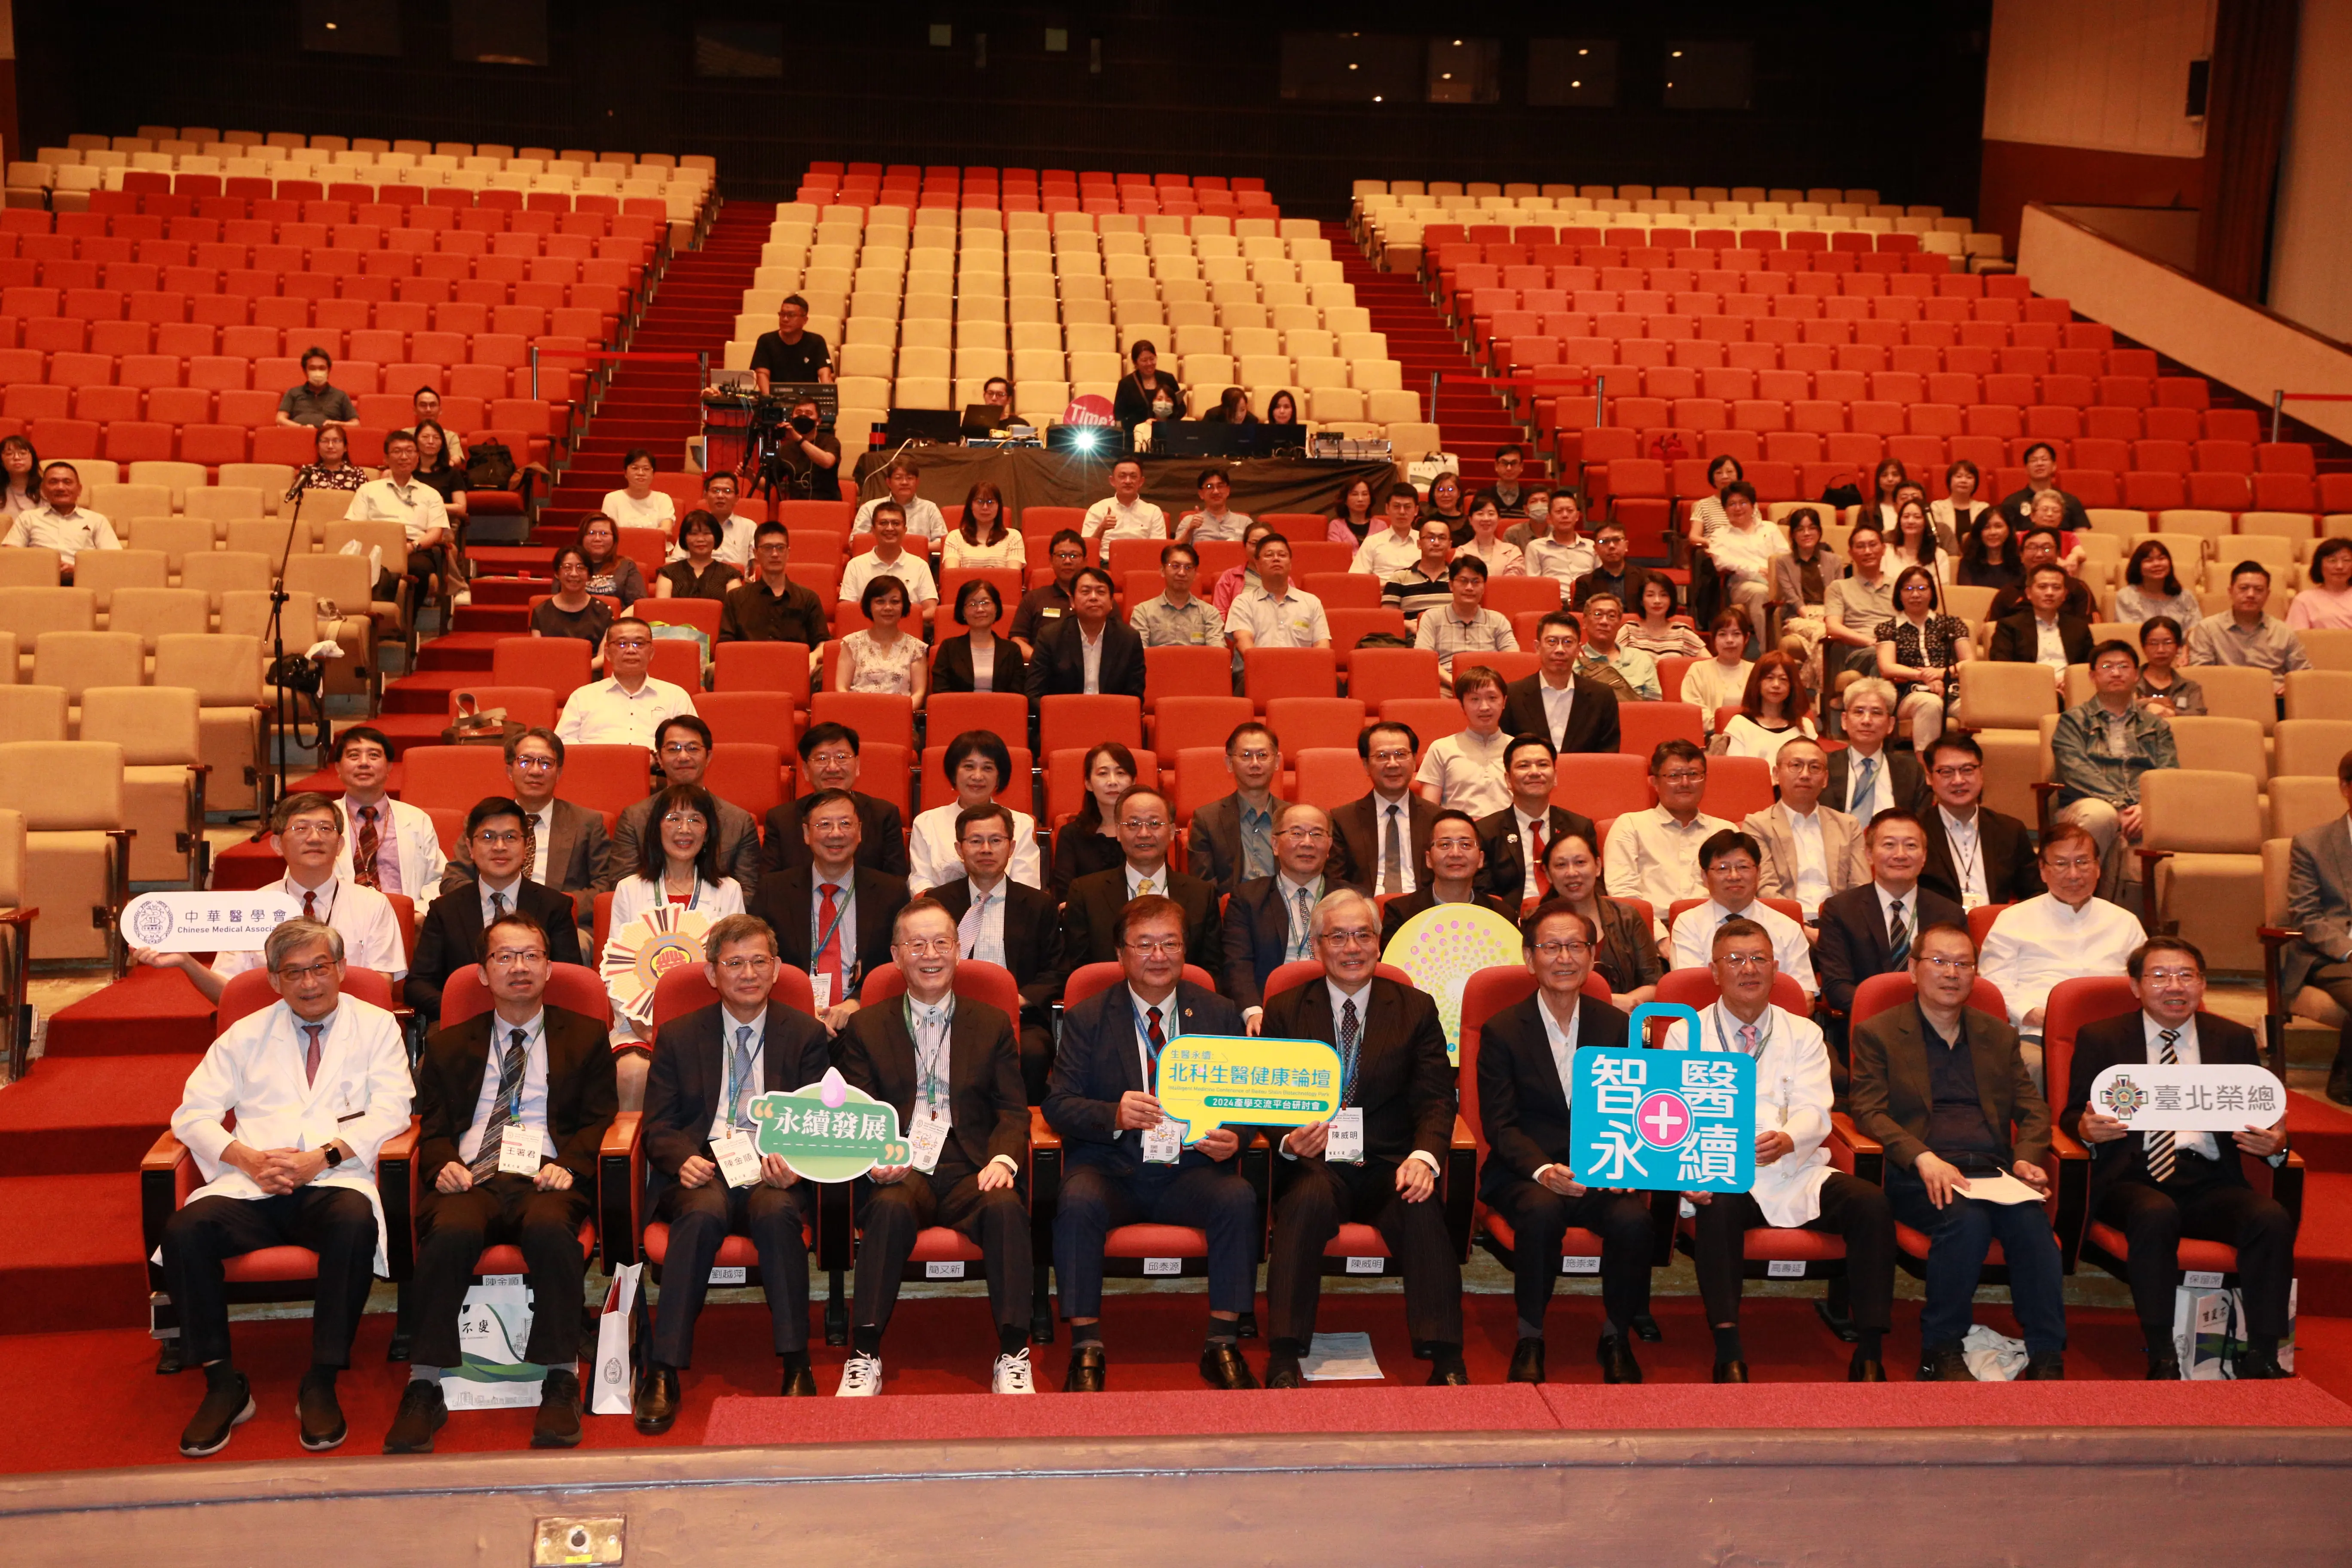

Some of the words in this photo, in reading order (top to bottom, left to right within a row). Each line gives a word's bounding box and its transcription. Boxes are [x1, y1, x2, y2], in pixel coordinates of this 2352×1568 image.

[185, 909, 287, 923] 中華醫學會
[1169, 1063, 1331, 1088] 北科生醫健康論壇
[2154, 1084, 2276, 1111] 臺北榮總
[1213, 1098, 1320, 1110] 2024產學交流平台研討會
[1332, 1131, 1357, 1139] 陳威明
[724, 1153, 753, 1168] 陳金順
[1148, 1262, 1179, 1271] 邱泰源
[1351, 1259, 1382, 1268] 陳威明
[929, 1265, 960, 1274] 簡又新
[2189, 1275, 2221, 1285] 保留席
